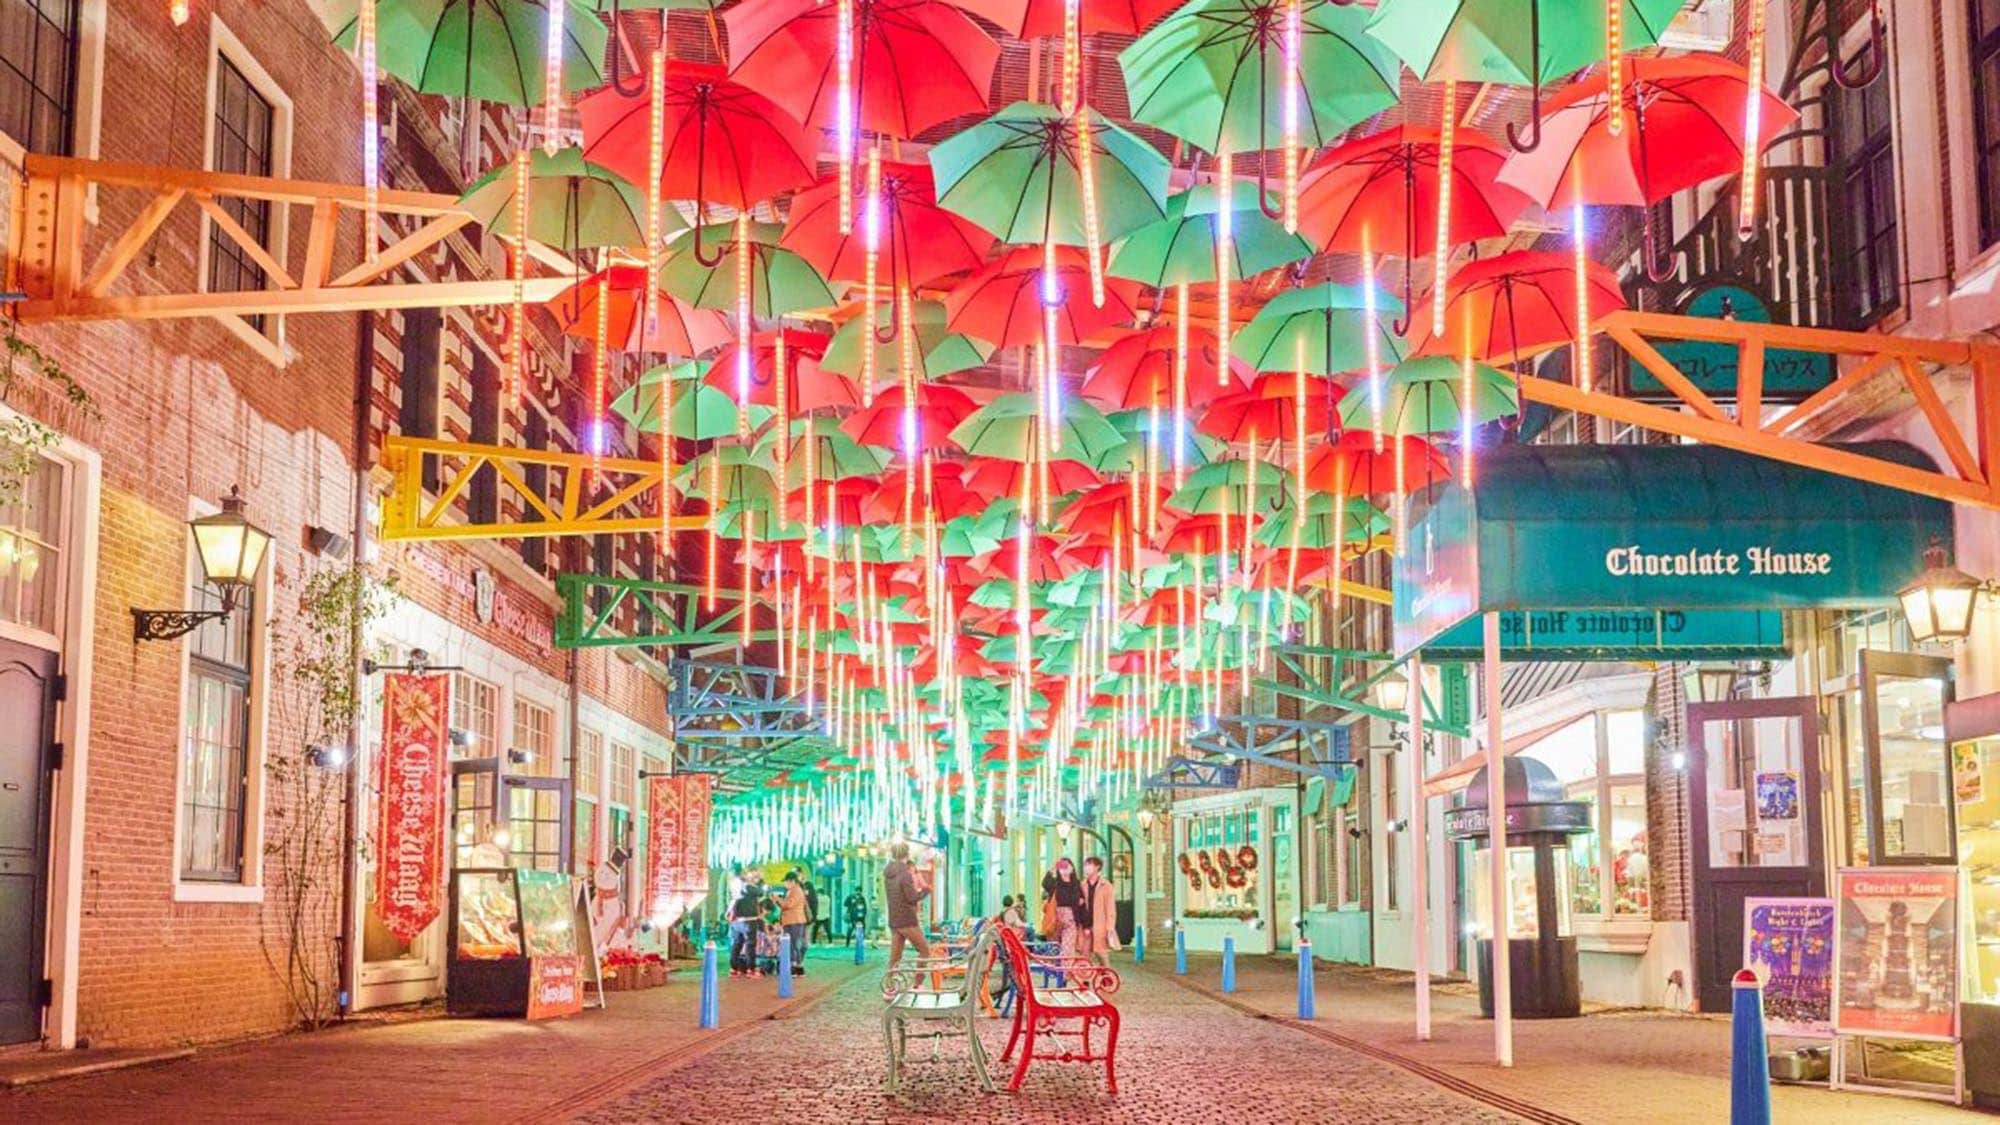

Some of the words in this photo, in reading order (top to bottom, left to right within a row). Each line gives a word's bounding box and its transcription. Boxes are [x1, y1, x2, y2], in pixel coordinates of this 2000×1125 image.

[1649, 356, 1817, 380] コレーハウス
[1605, 545, 1741, 576] Chocolate
[1746, 546, 1832, 576] House
[402, 743, 431, 830] Cheese
[391, 833, 426, 907] Waag
